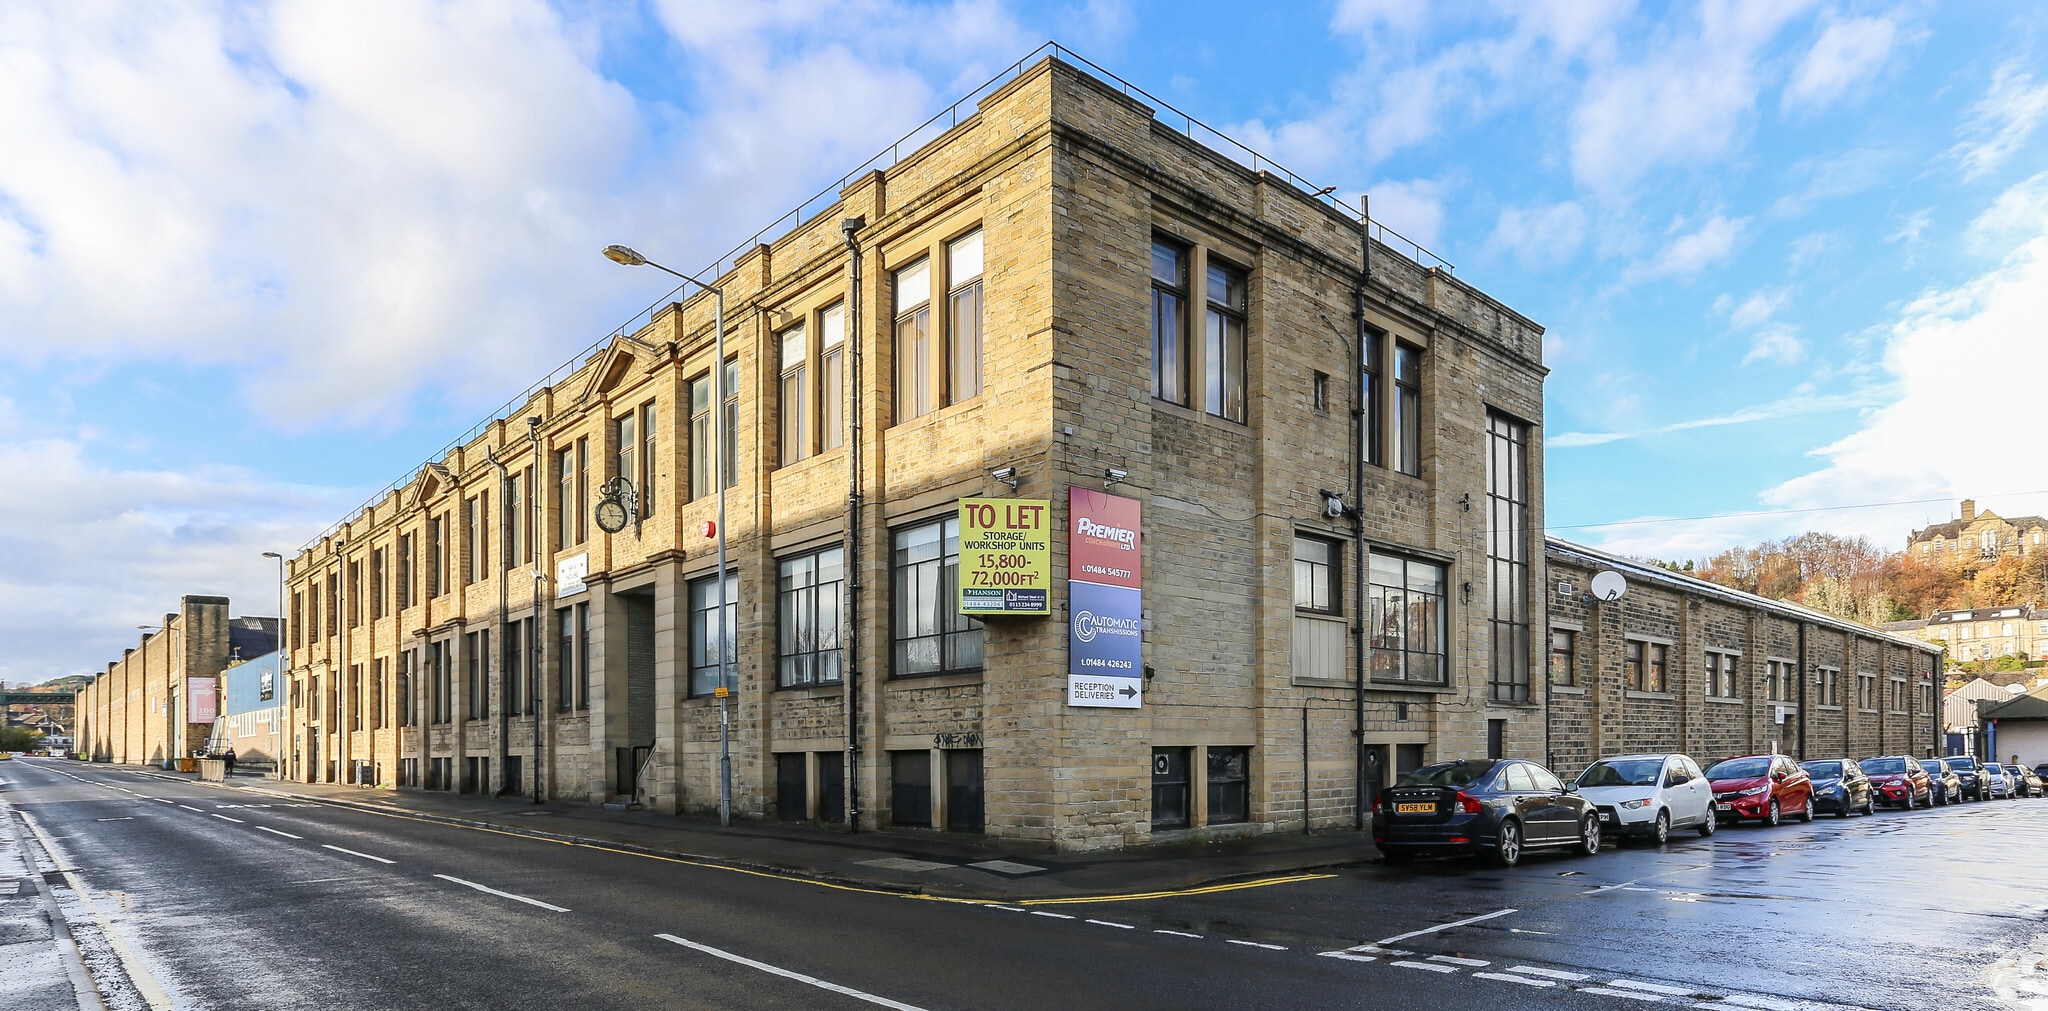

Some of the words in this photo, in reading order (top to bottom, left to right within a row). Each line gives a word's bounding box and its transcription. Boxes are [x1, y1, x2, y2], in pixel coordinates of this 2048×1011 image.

[965, 504, 996, 529] TO
[1006, 505, 1044, 530] LET
[983, 531, 1027, 541] STORAGE/
[964, 541, 1017, 550] WORKSHOP
[1019, 541, 1045, 551] UNITS
[1120, 543, 1131, 551] LTD
[978, 554, 1032, 570] 15,800-
[1107, 567, 1131, 578] 545777
[1091, 615, 1139, 630] AUTOMATIC
[1096, 626, 1139, 637] TRANSMISSIONS
[1107, 660, 1132, 669] 426243
[1074, 682, 1114, 691] RECEPTION
[1074, 691, 1115, 700] DELIVERIES
